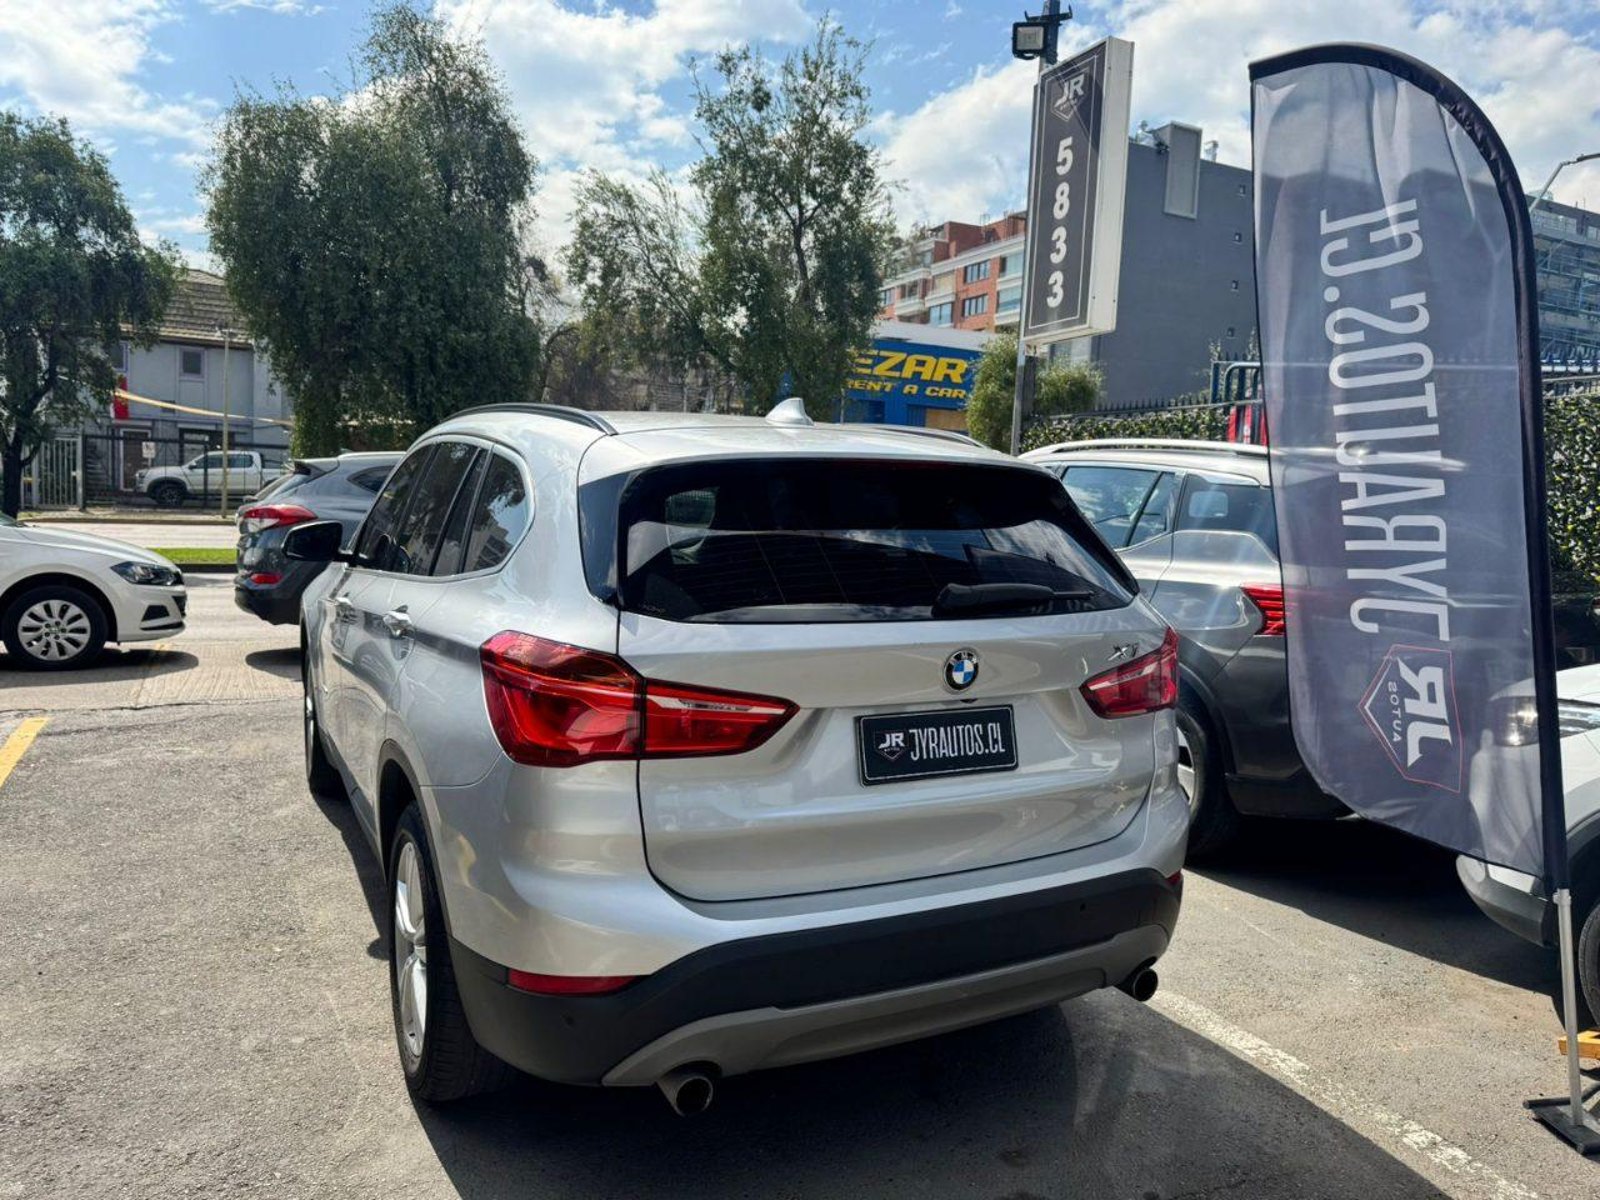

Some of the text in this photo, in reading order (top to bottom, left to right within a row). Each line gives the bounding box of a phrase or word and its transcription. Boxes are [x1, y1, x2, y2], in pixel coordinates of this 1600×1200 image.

[1046, 136, 1073, 308] 5833
[903, 384, 918, 394] A
[925, 386, 966, 398] CAR
[878, 722, 1006, 761] JR JYRAUTOS.CL
